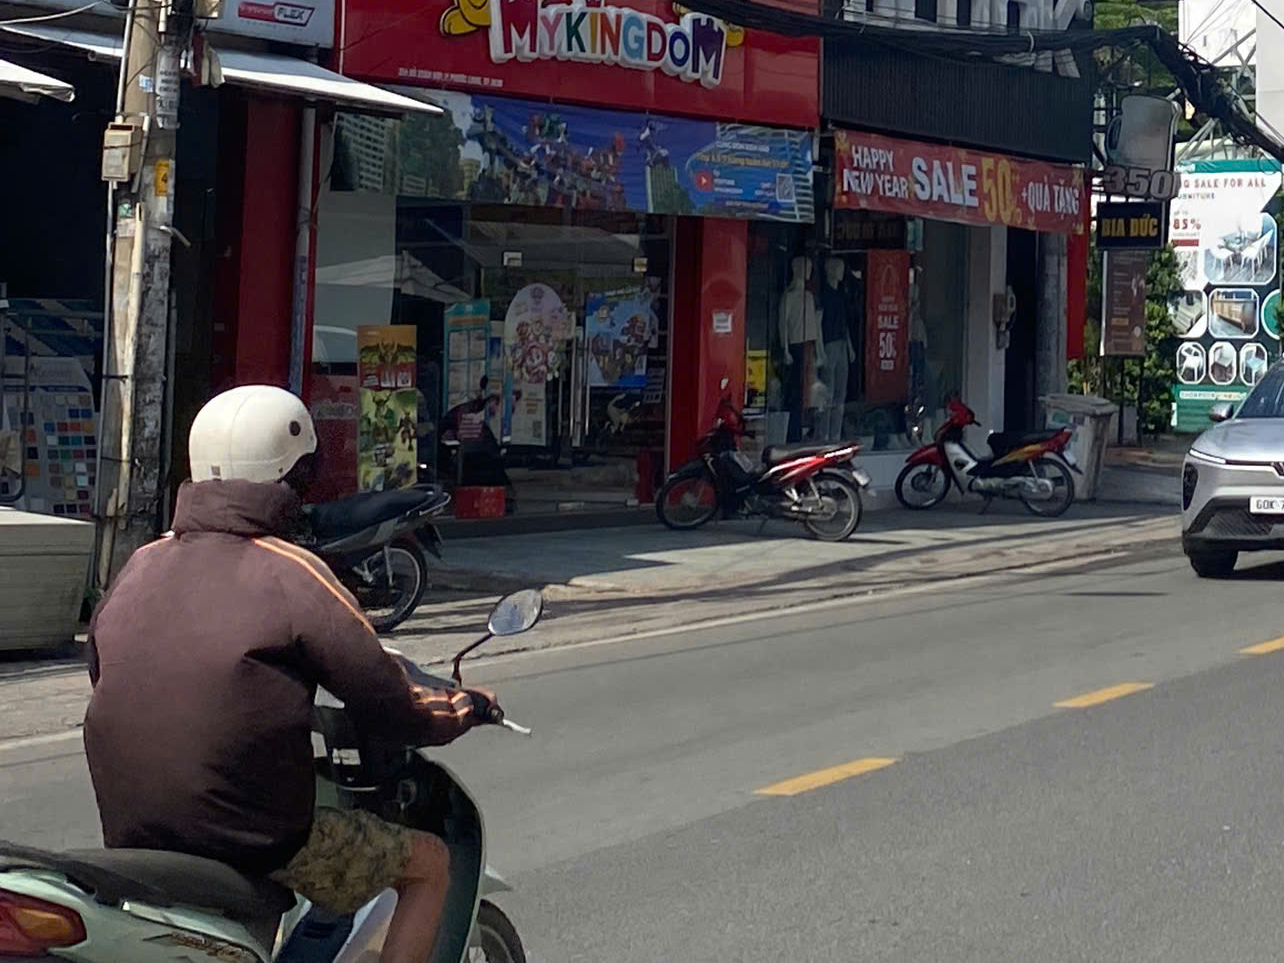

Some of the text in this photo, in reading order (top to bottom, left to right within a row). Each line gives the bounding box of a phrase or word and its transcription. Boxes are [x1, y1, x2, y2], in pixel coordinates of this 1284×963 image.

[852, 145, 894, 172] HAPPY
[876, 173, 909, 199] YEAR
[912, 157, 979, 207] SALE
[1103, 165, 1176, 199] 350
[1194, 179, 1219, 188] SALE
[1224, 179, 1243, 188] FOR
[1248, 178, 1266, 187] ALL
[1101, 218, 1125, 237] BIA
[1173, 219, 1201, 230] 85%
